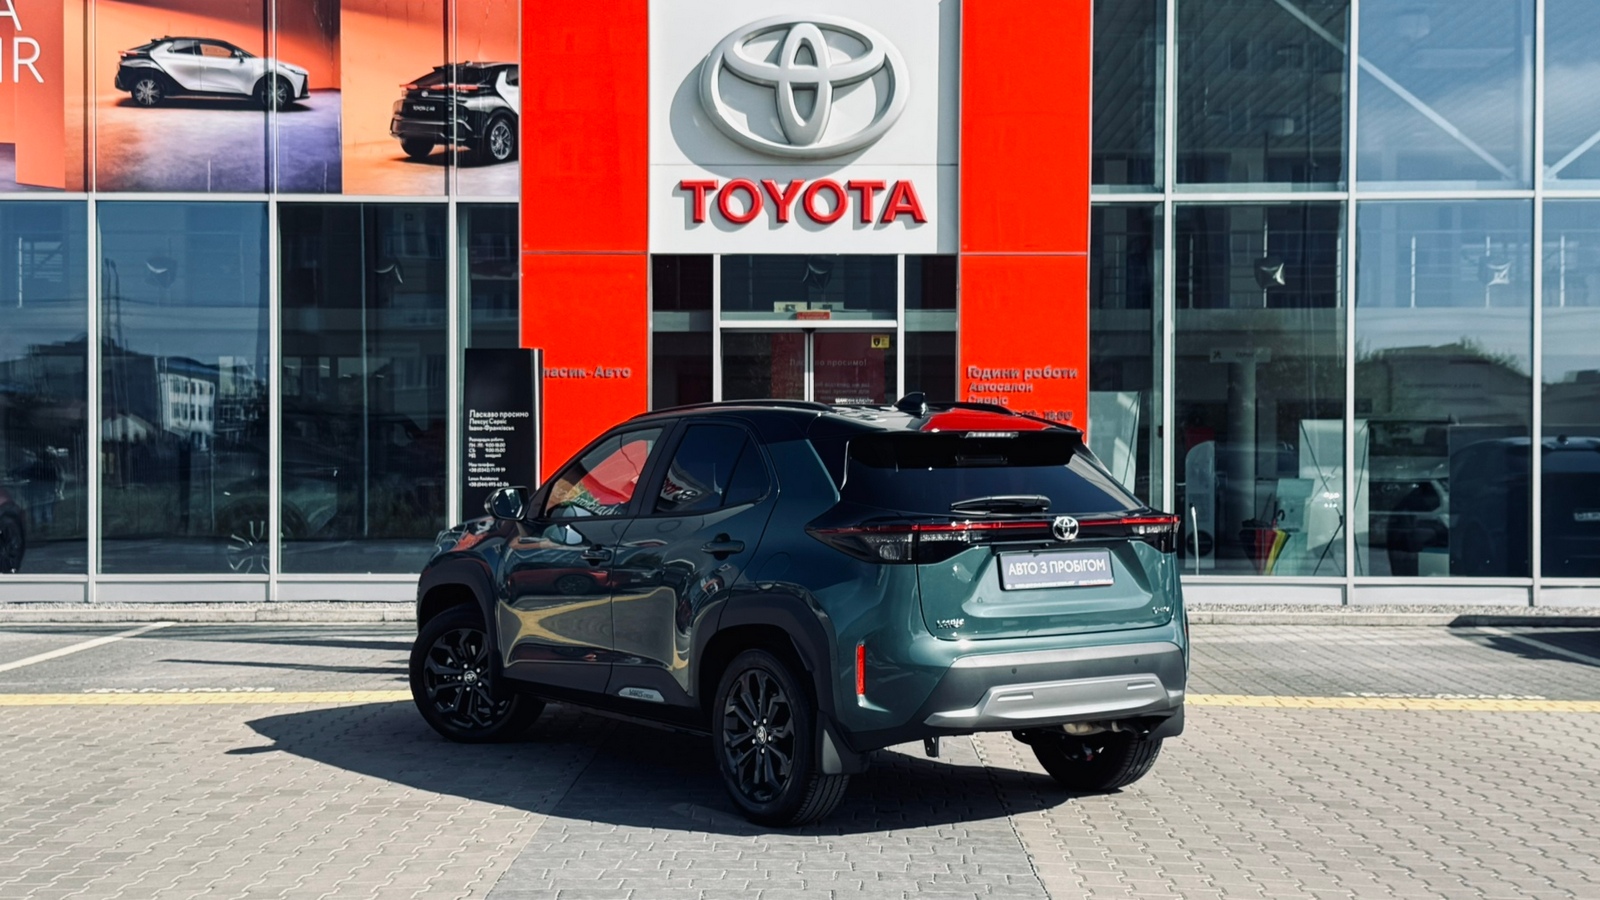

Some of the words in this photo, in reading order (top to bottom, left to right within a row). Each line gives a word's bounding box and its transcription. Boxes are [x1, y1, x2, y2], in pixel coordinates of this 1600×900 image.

[680, 178, 928, 224] TOYOTA
[966, 365, 1019, 380] Години
[1024, 365, 1078, 381] роботи
[968, 382, 1033, 392] Автосалон
[499, 411, 529, 419] просимо
[1008, 561, 1038, 576] АВТО
[1040, 561, 1048, 574] З
[1050, 558, 1106, 574] ПРОБІГОМ
